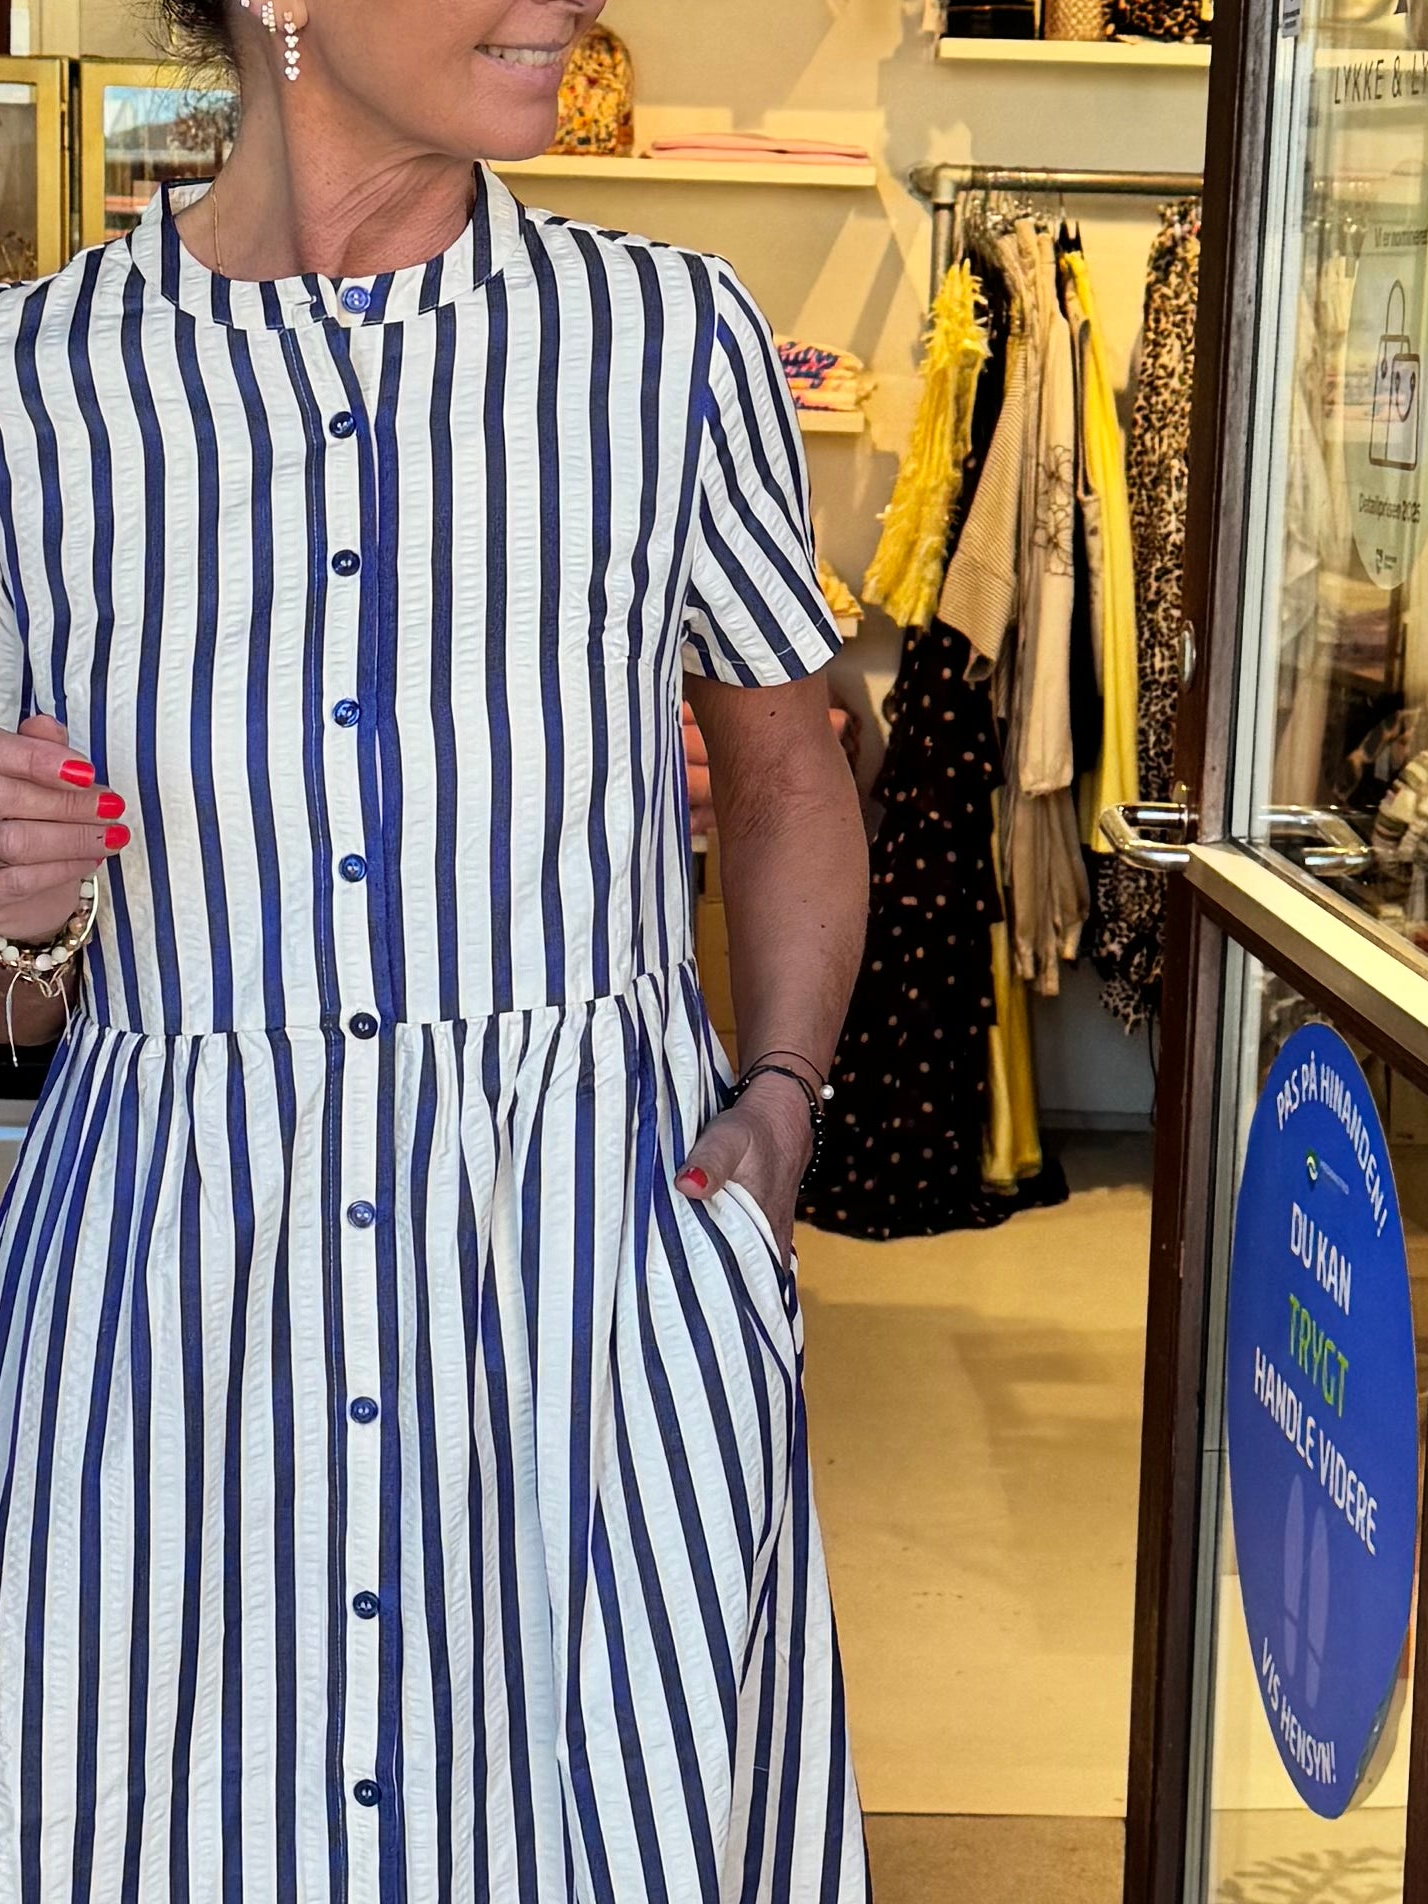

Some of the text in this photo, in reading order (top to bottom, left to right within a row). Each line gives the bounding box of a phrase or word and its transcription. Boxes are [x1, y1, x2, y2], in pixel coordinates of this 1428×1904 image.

[1334, 59, 1384, 104] LYKKE
[1277, 1050, 1388, 1238] PAS PÅ HINANDEN!
[1290, 1201, 1352, 1316] DU KAN
[1289, 1293, 1350, 1418] TRYGT
[1254, 1346, 1378, 1556] HANDLE VIDERE
[1262, 1637, 1336, 1784] VIS HENSYN!
